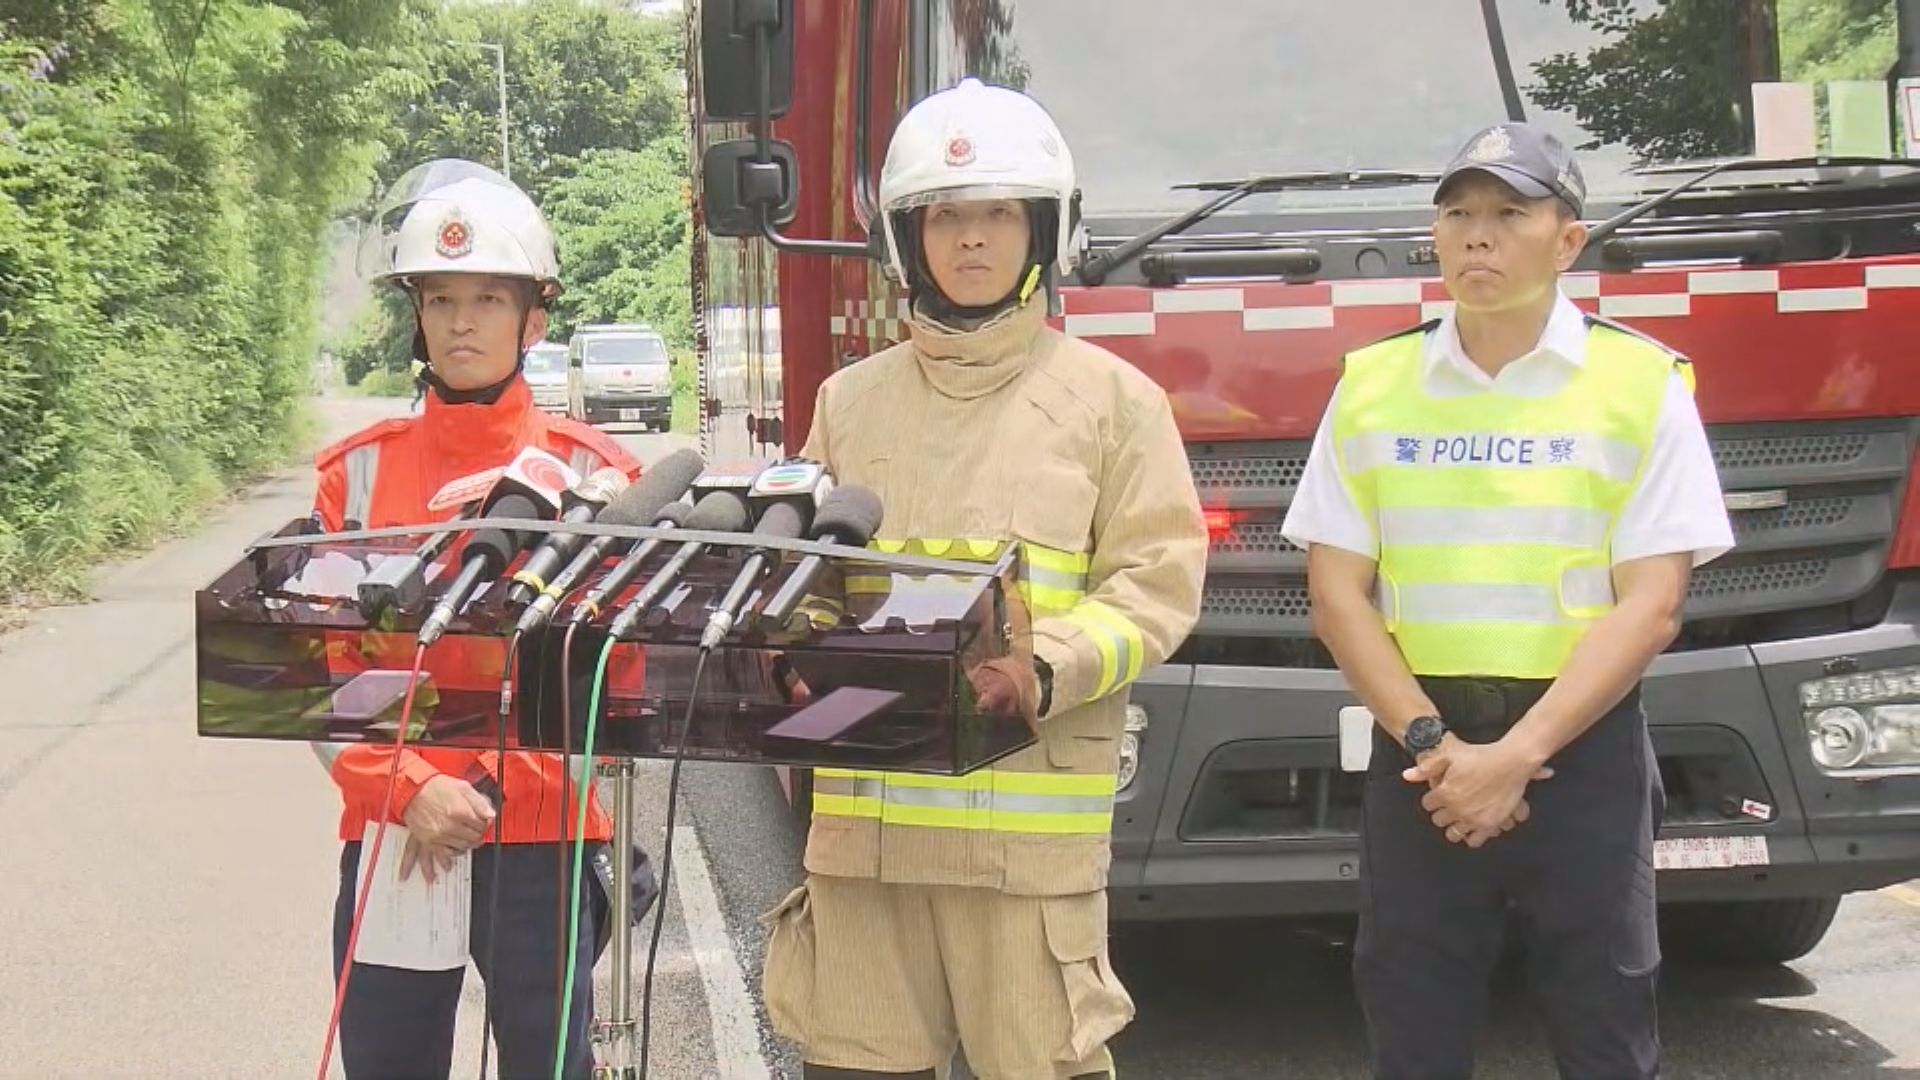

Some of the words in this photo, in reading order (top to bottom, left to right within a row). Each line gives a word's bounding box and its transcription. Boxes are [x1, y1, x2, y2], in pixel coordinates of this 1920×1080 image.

[1394, 437, 1421, 463] 警
[1432, 436, 1535, 464] POLICE
[1549, 437, 1575, 462] 察
